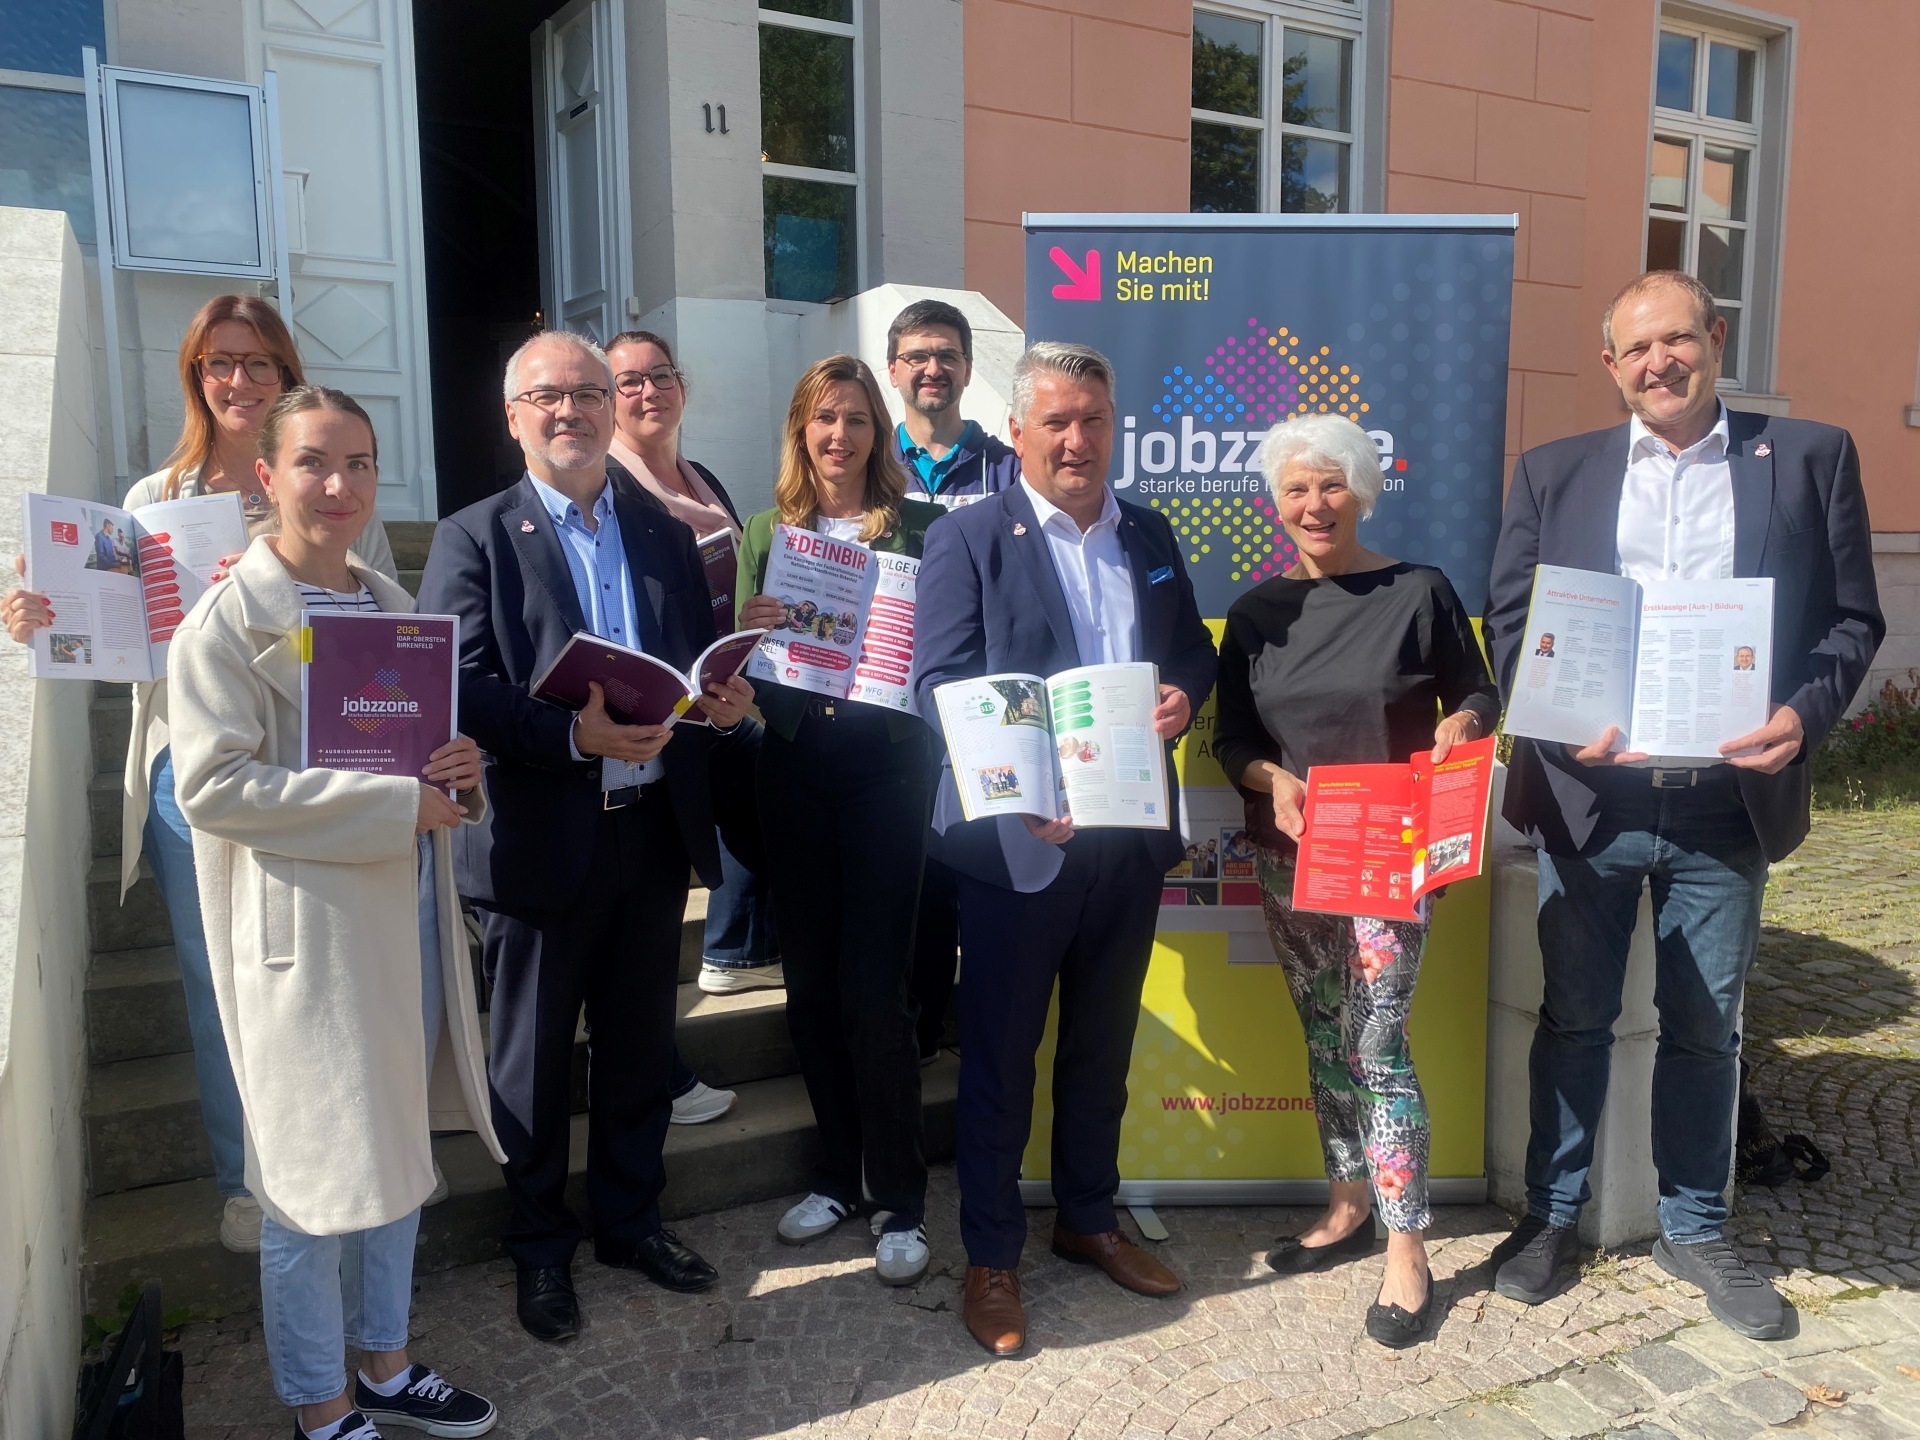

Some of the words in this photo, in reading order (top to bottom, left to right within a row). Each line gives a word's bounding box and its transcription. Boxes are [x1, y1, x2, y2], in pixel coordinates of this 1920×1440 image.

[702, 102, 730, 135] 11
[1117, 250, 1213, 273] Machen
[1116, 277, 1154, 301] Sie
[1161, 277, 1209, 301] mit!
[1114, 415, 1407, 489] jobzze.
[1139, 475, 1195, 493] starke
[1201, 475, 1259, 493] berufe
[785, 532, 867, 571] #DEINBIR
[794, 556, 815, 566] Kampagne
[876, 557, 911, 574] FOLGE
[1546, 589, 1578, 600] Attraktive
[1579, 593, 1620, 606] Unternehmen
[1643, 602, 1688, 612] Erstklassige
[1714, 602, 1744, 612] Bildung
[396, 625, 420, 635] 2026
[396, 635, 446, 643] IDAR-OBERSTEIN
[759, 643, 777, 655] ZIEL:
[757, 660, 772, 670] WFG
[865, 685, 882, 696] WFG
